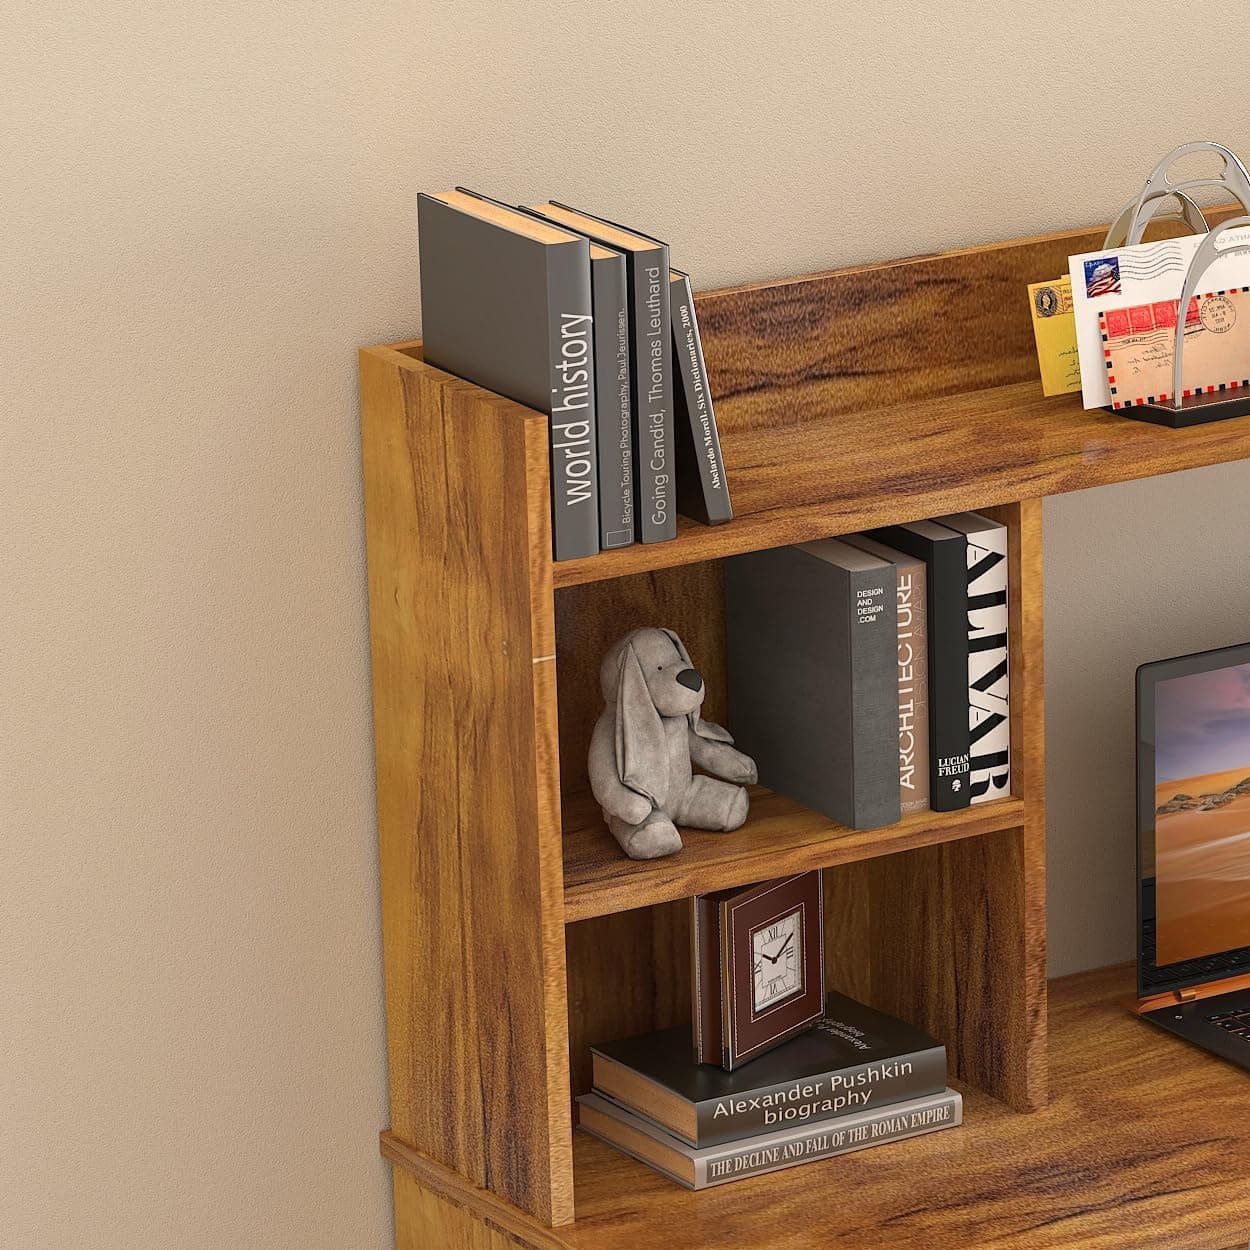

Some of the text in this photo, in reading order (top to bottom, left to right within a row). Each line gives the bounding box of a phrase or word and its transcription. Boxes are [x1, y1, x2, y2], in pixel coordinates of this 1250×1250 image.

[680, 305, 690, 328] 2000
[617, 359, 627, 380] Paul
[686, 329, 703, 392] Dictionaries,
[552, 313, 593, 506] world history
[645, 267, 668, 525] Going Candid, Thomas Leuthard
[696, 392, 706, 410] Six
[619, 381, 630, 448] Photography,
[621, 450, 631, 487] Touring
[706, 448, 721, 489] Abelardo
[622, 489, 632, 524] Bicycle
[857, 587, 883, 598] DESIGN
[857, 598, 873, 607] AND
[857, 604, 884, 616] DESIGN
[857, 615, 877, 624] .COM
[897, 574, 916, 790] ARCHITECTURE
[967, 540, 1009, 800] ALIVAR
[938, 753, 969, 767] LUCIAN
[938, 763, 970, 777] FREUD
[713, 1062, 912, 1119] Alexander Pushkin
[764, 1090, 872, 1125] biography
[710, 1105, 950, 1177] THE DECLINE AND FALL OF THE ROMAN EMPIRE
